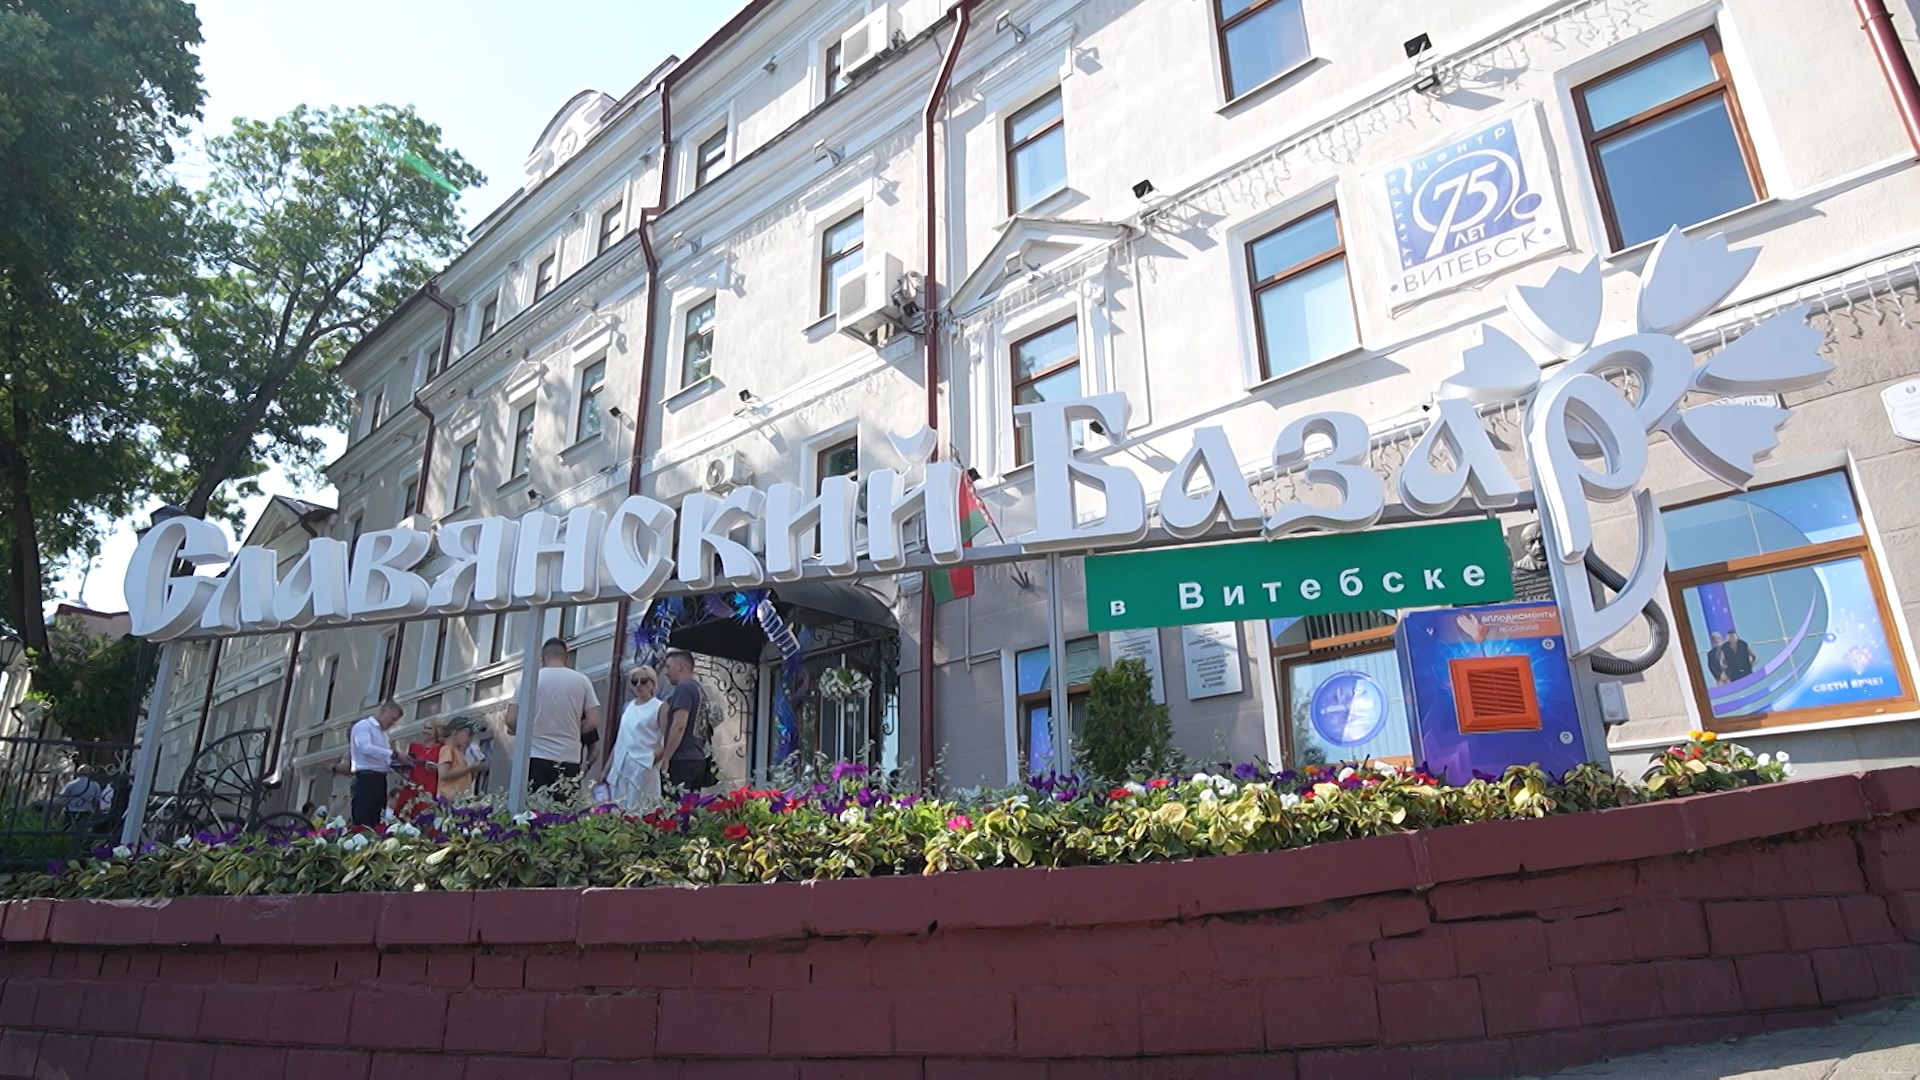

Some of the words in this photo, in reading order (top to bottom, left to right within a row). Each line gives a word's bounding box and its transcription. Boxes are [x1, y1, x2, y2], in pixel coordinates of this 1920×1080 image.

[1424, 161, 1499, 260] 75
[1454, 224, 1486, 248] ЛЕТ
[1403, 227, 1540, 293] ВИТЕБСК
[1110, 597, 1126, 617] в
[1178, 562, 1486, 611] Витебске
